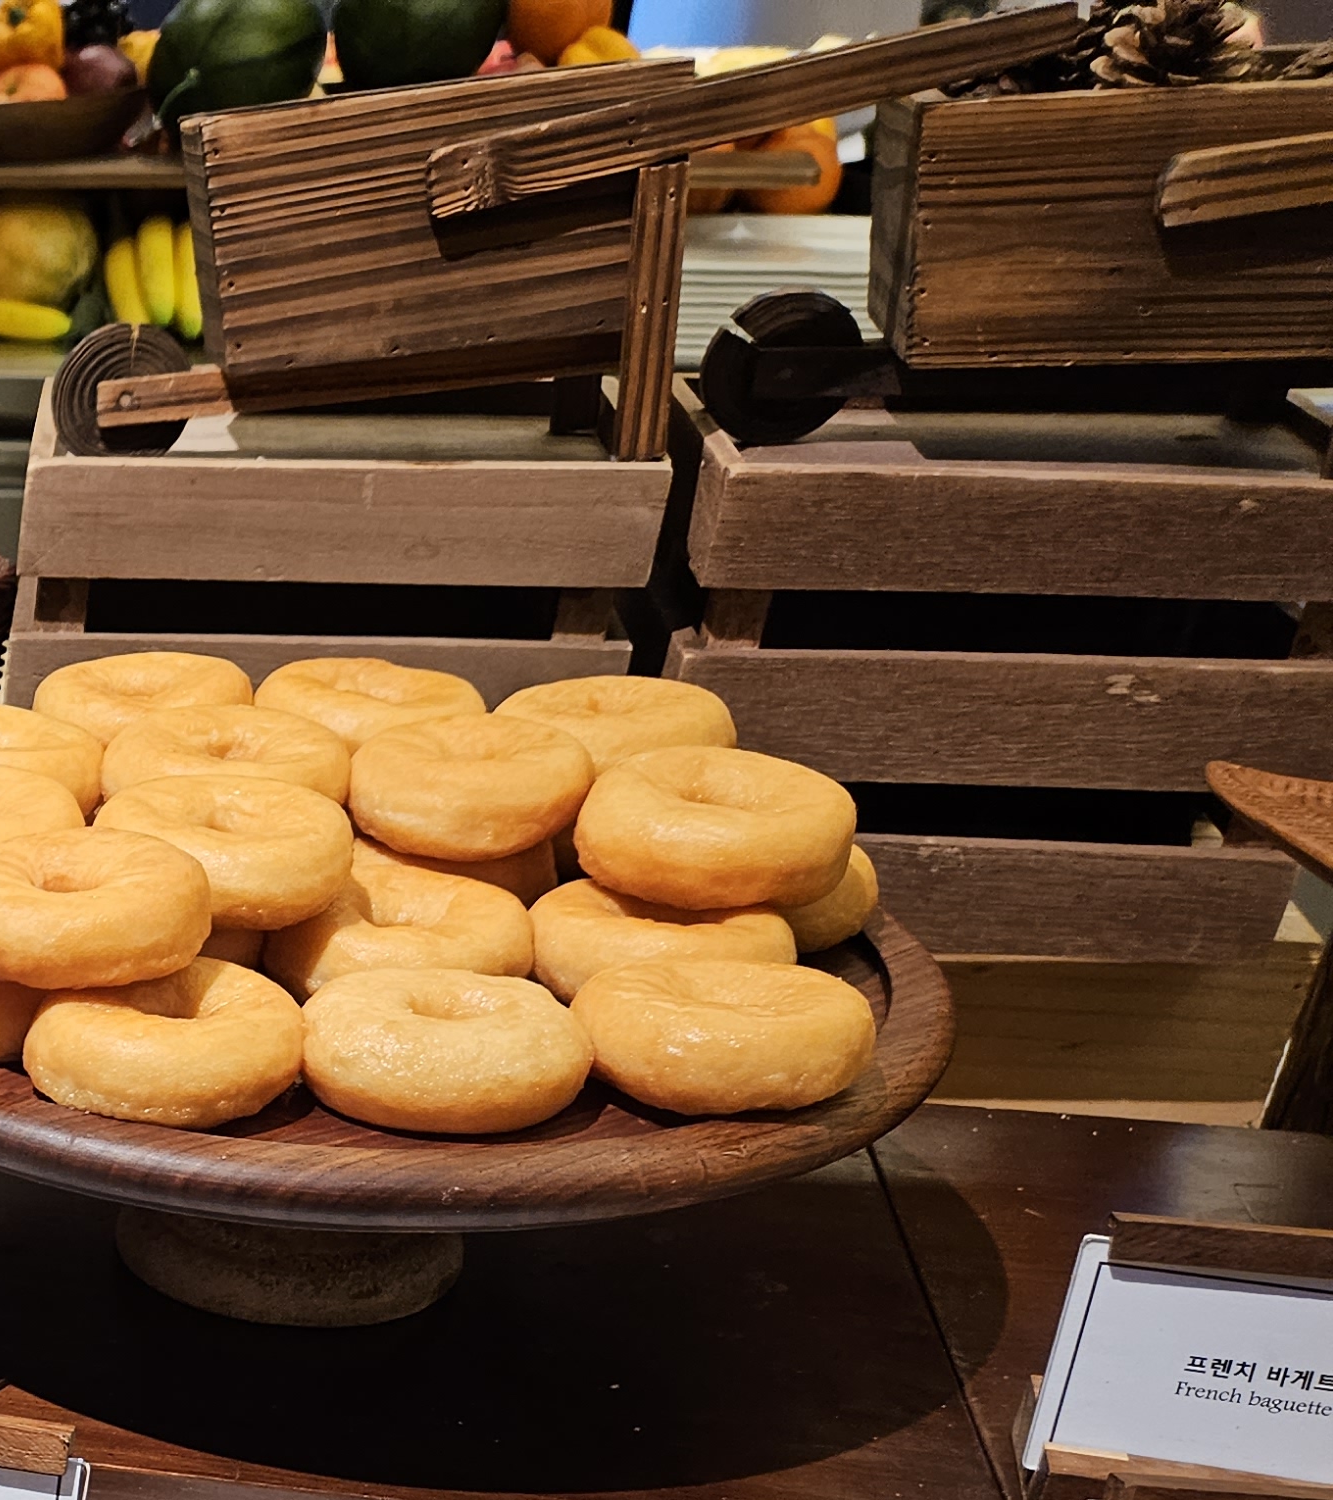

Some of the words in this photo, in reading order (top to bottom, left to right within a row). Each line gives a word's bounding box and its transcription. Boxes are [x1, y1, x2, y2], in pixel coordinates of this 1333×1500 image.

[1183, 1355, 1257, 1383] 프렌치
[1266, 1366, 1333, 1392] 바게트
[1174, 1380, 1242, 1404] French
[1248, 1391, 1333, 1417] baguette
